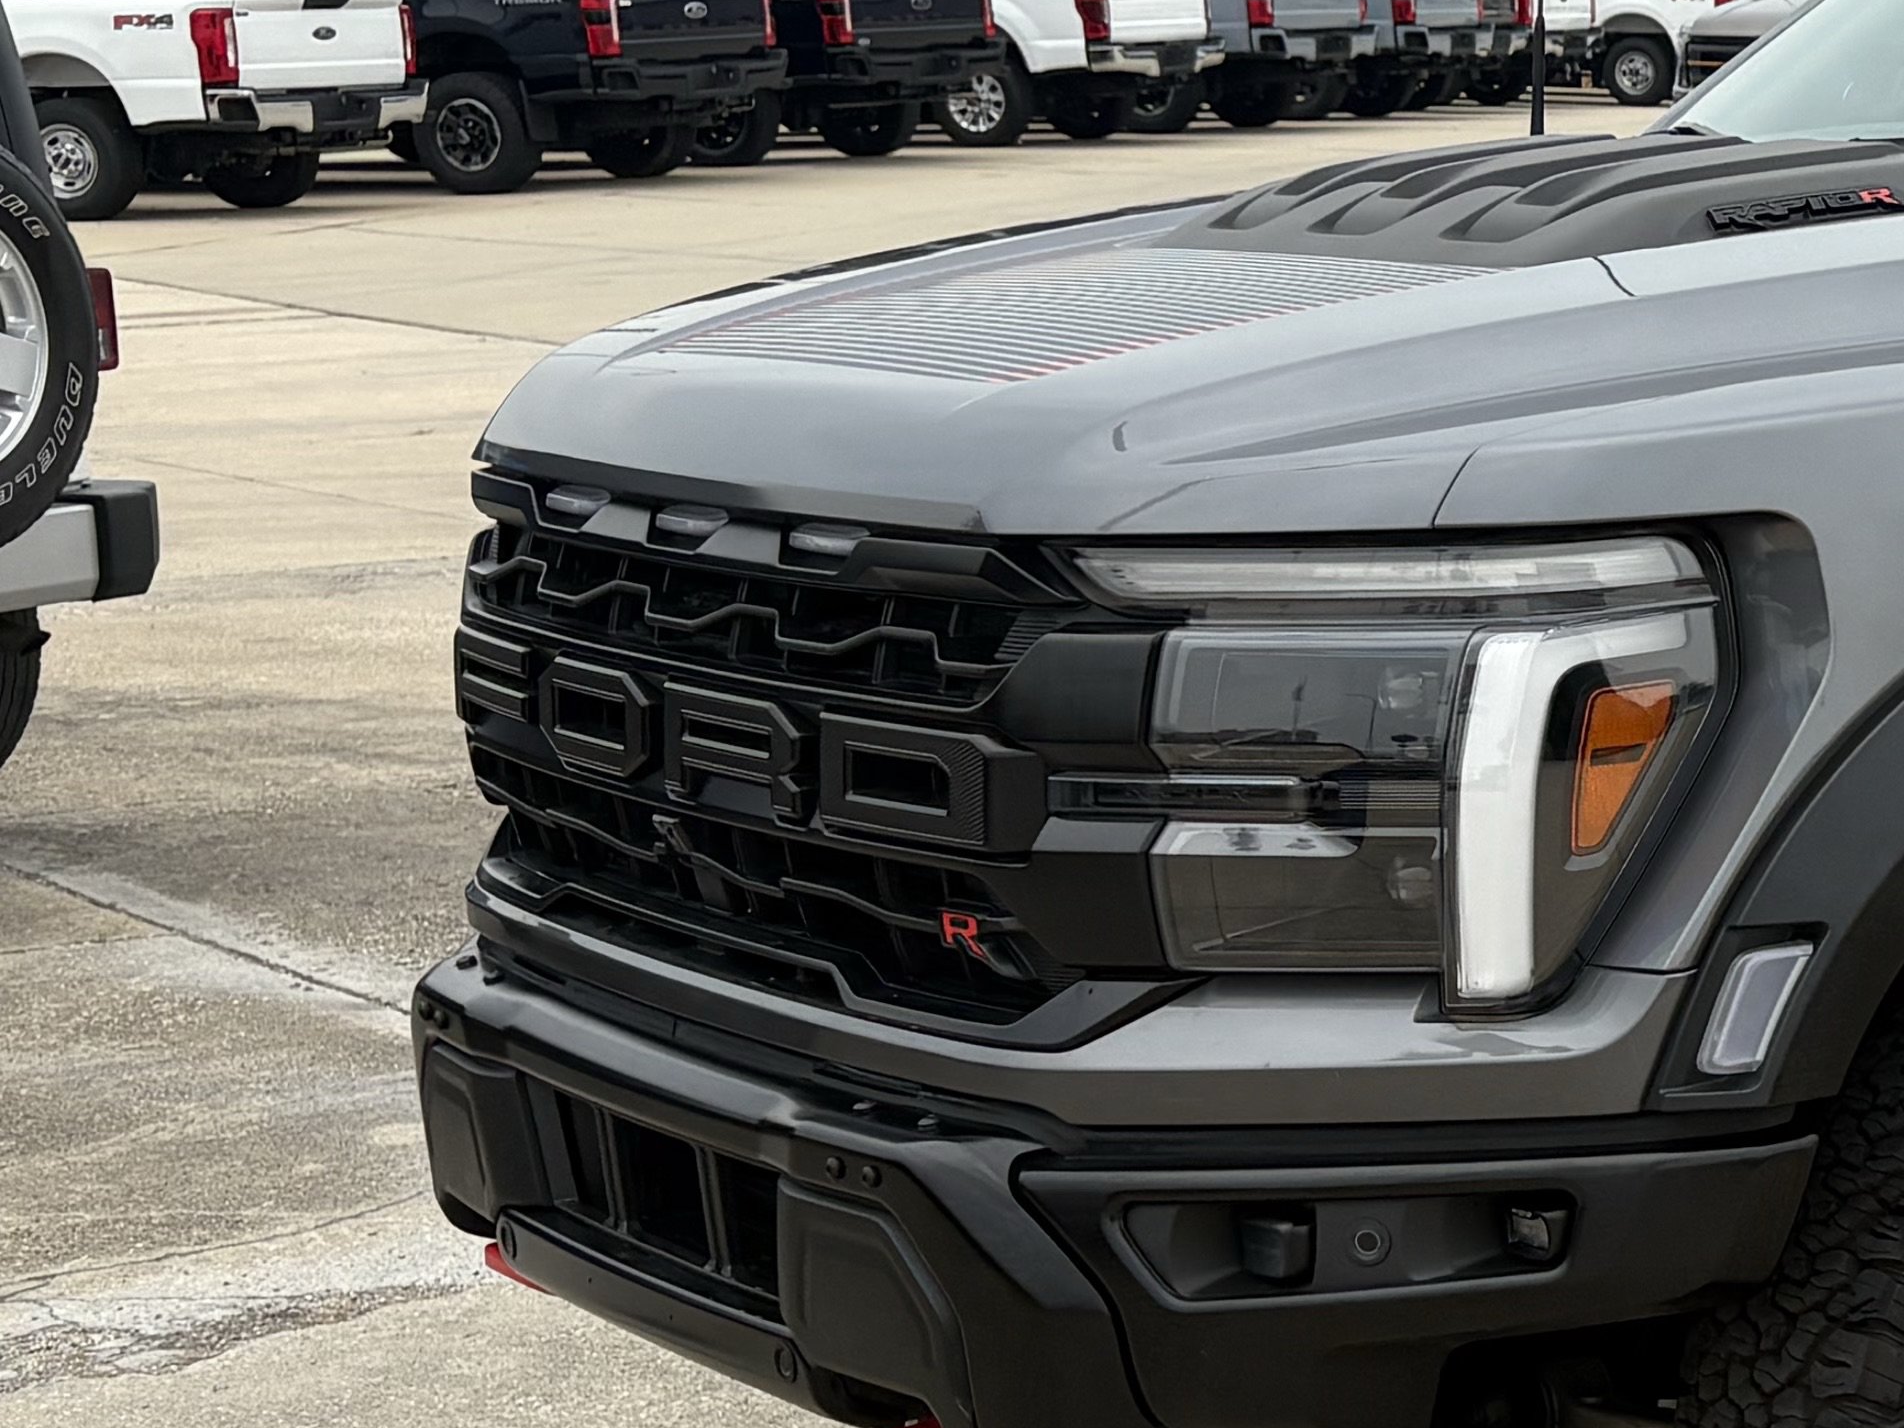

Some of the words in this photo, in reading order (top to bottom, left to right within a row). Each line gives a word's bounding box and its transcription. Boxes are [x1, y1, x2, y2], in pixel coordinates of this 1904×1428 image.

[113, 14, 173, 30] FX4
[0, 362, 83, 506] DUELE
[455, 624, 1000, 849] FORD
[940, 910, 990, 960] R
